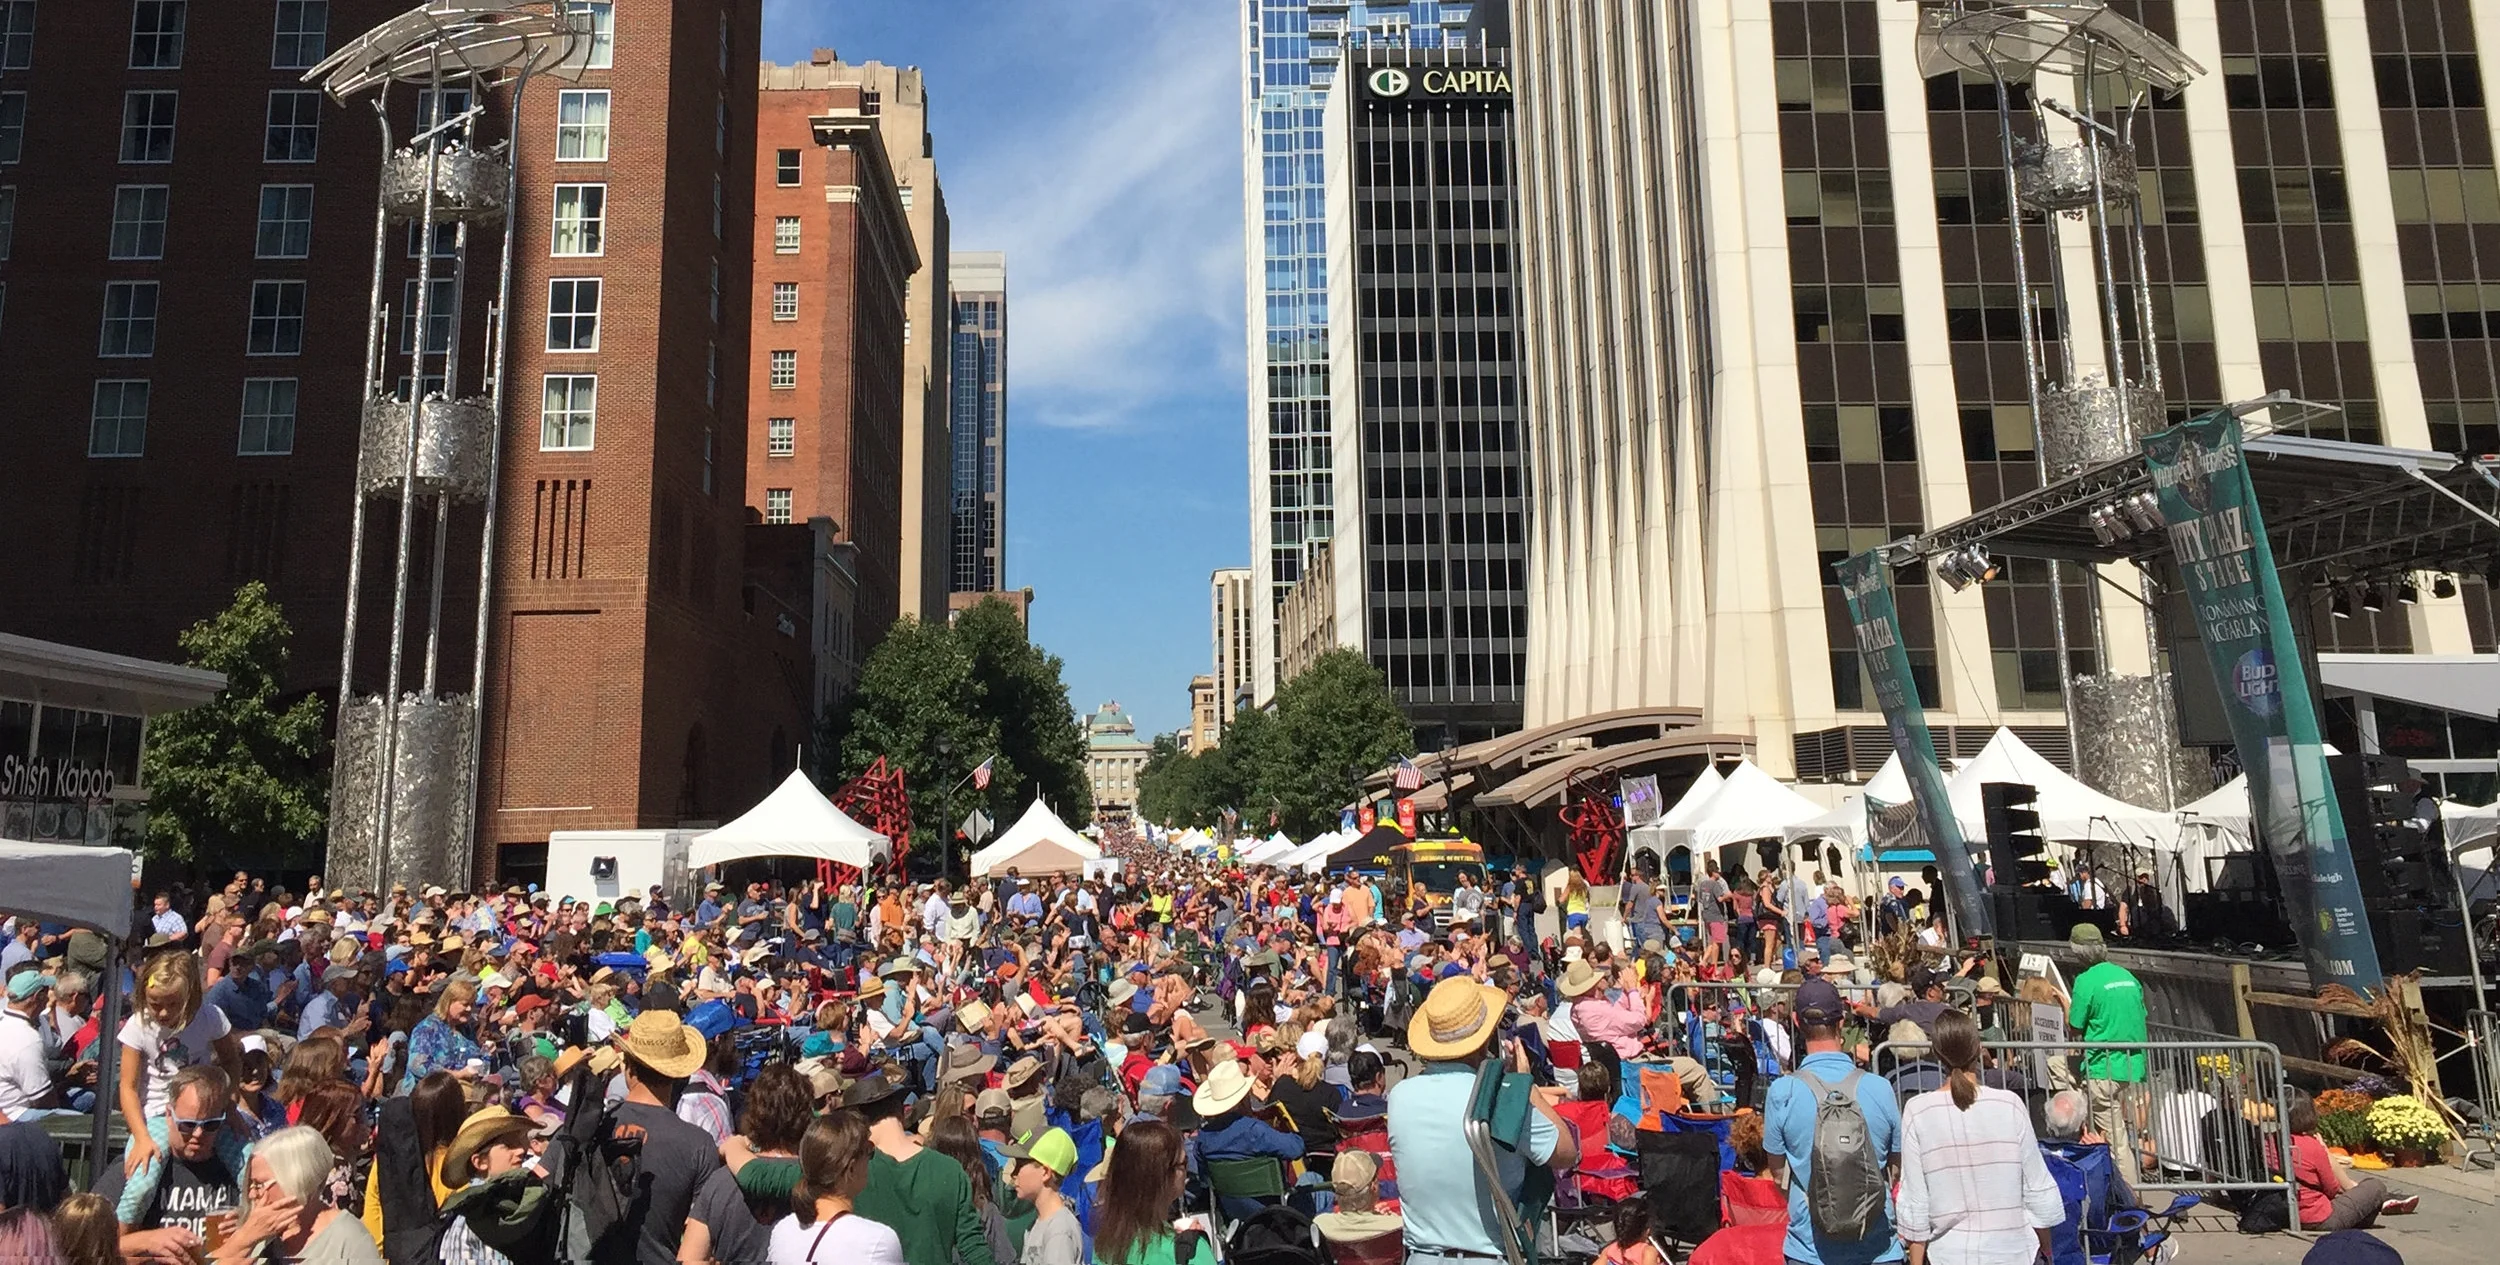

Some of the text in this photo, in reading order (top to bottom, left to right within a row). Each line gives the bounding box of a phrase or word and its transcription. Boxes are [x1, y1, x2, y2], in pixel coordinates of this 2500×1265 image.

[1422, 70, 1512, 94] CAPITA
[2241, 664, 2276, 681] BUD
[2240, 678, 2280, 697] LIGHT
[1, 754, 115, 799] Shish Kabob
